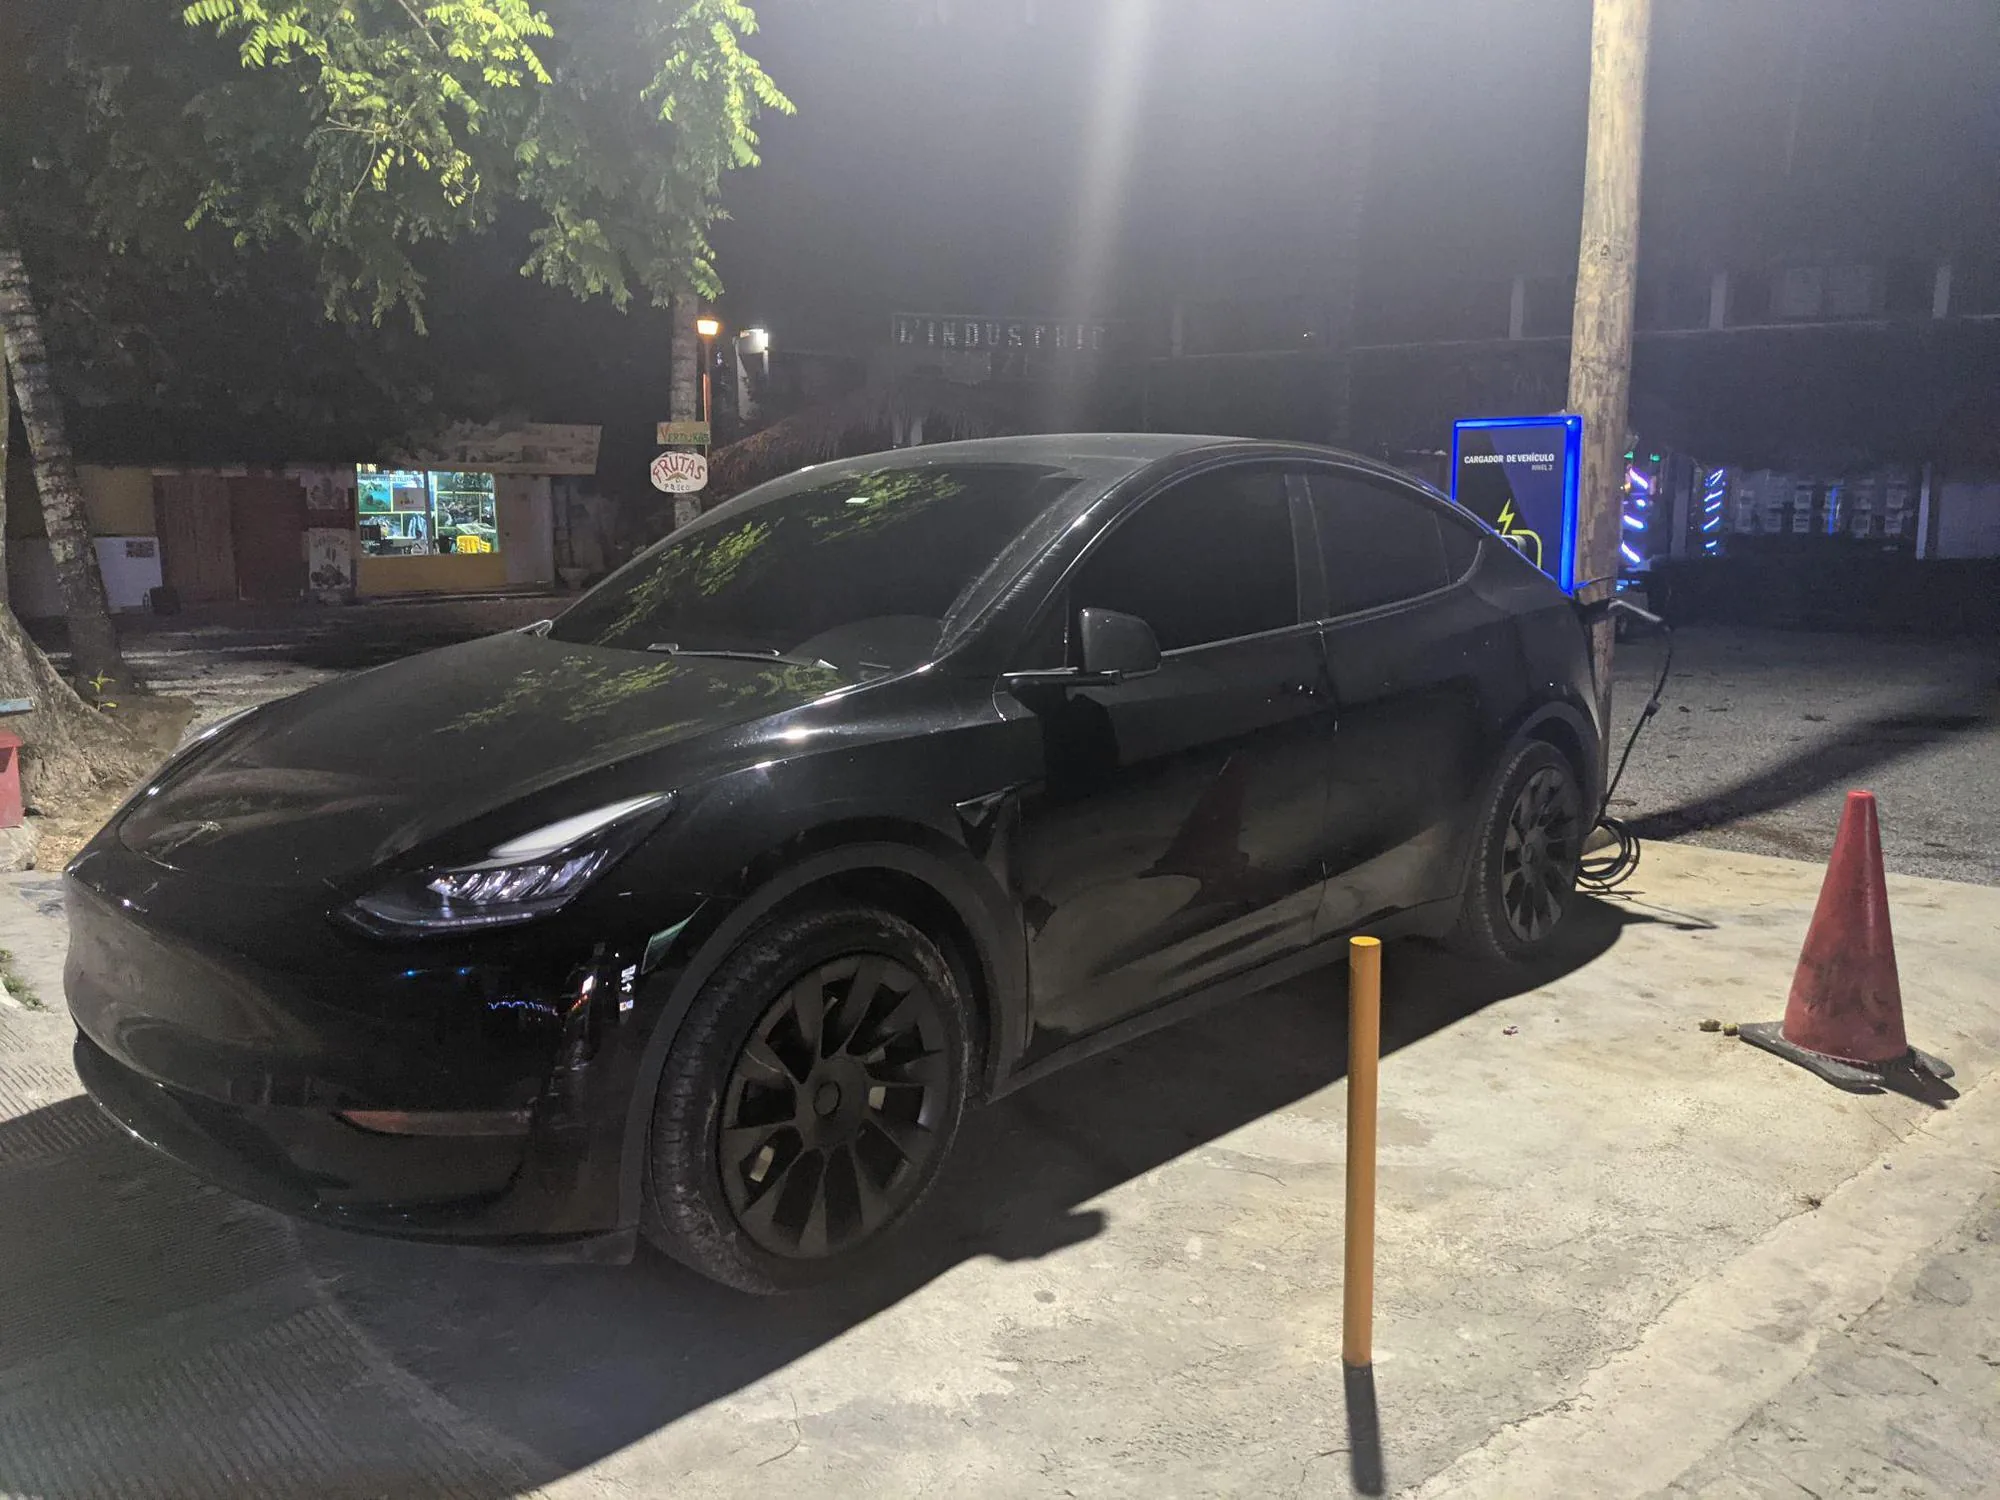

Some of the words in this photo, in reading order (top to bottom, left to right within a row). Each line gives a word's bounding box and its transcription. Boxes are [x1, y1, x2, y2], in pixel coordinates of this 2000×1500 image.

[1464, 455, 1504, 464] CARGADOR
[1506, 454, 1517, 463] DE
[1517, 452, 1555, 462] VEHÍCULO
[653, 456, 705, 483] FRUTAS
